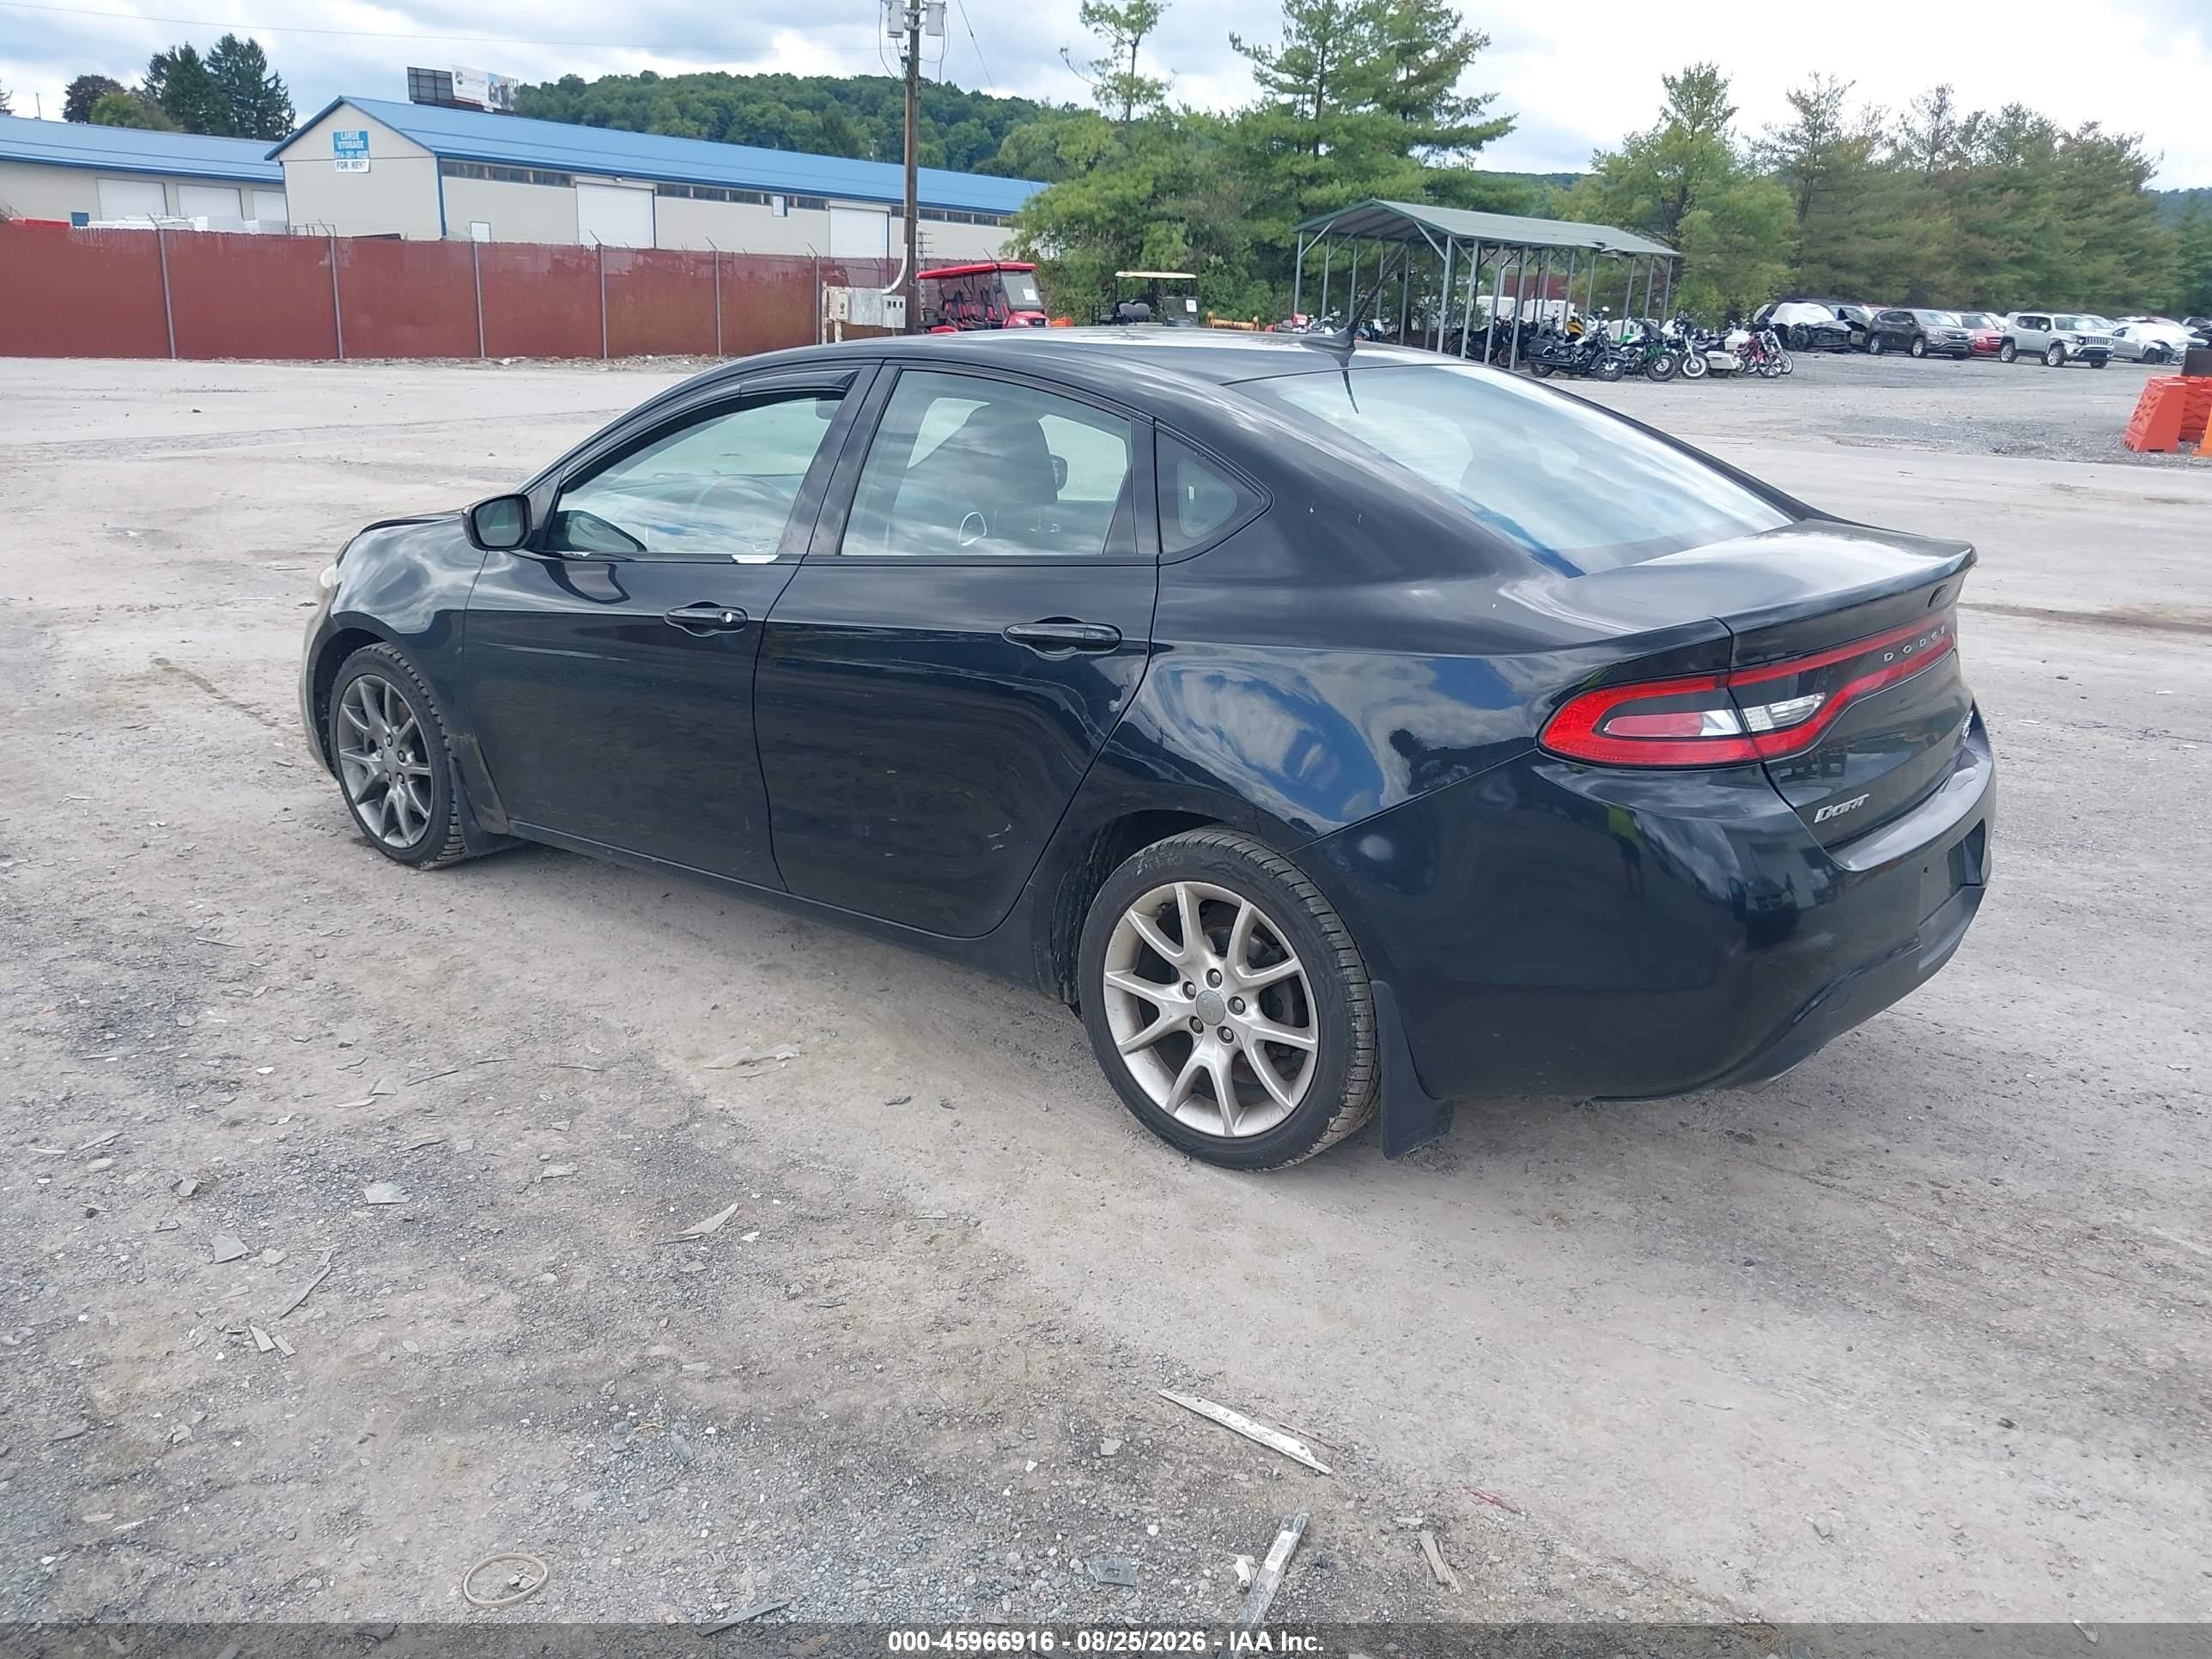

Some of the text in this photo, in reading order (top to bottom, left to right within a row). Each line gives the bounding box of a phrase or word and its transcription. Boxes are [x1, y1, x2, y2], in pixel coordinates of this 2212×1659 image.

[336, 161, 367, 169] FOR RENT
[1883, 625, 1945, 662] DODGE
